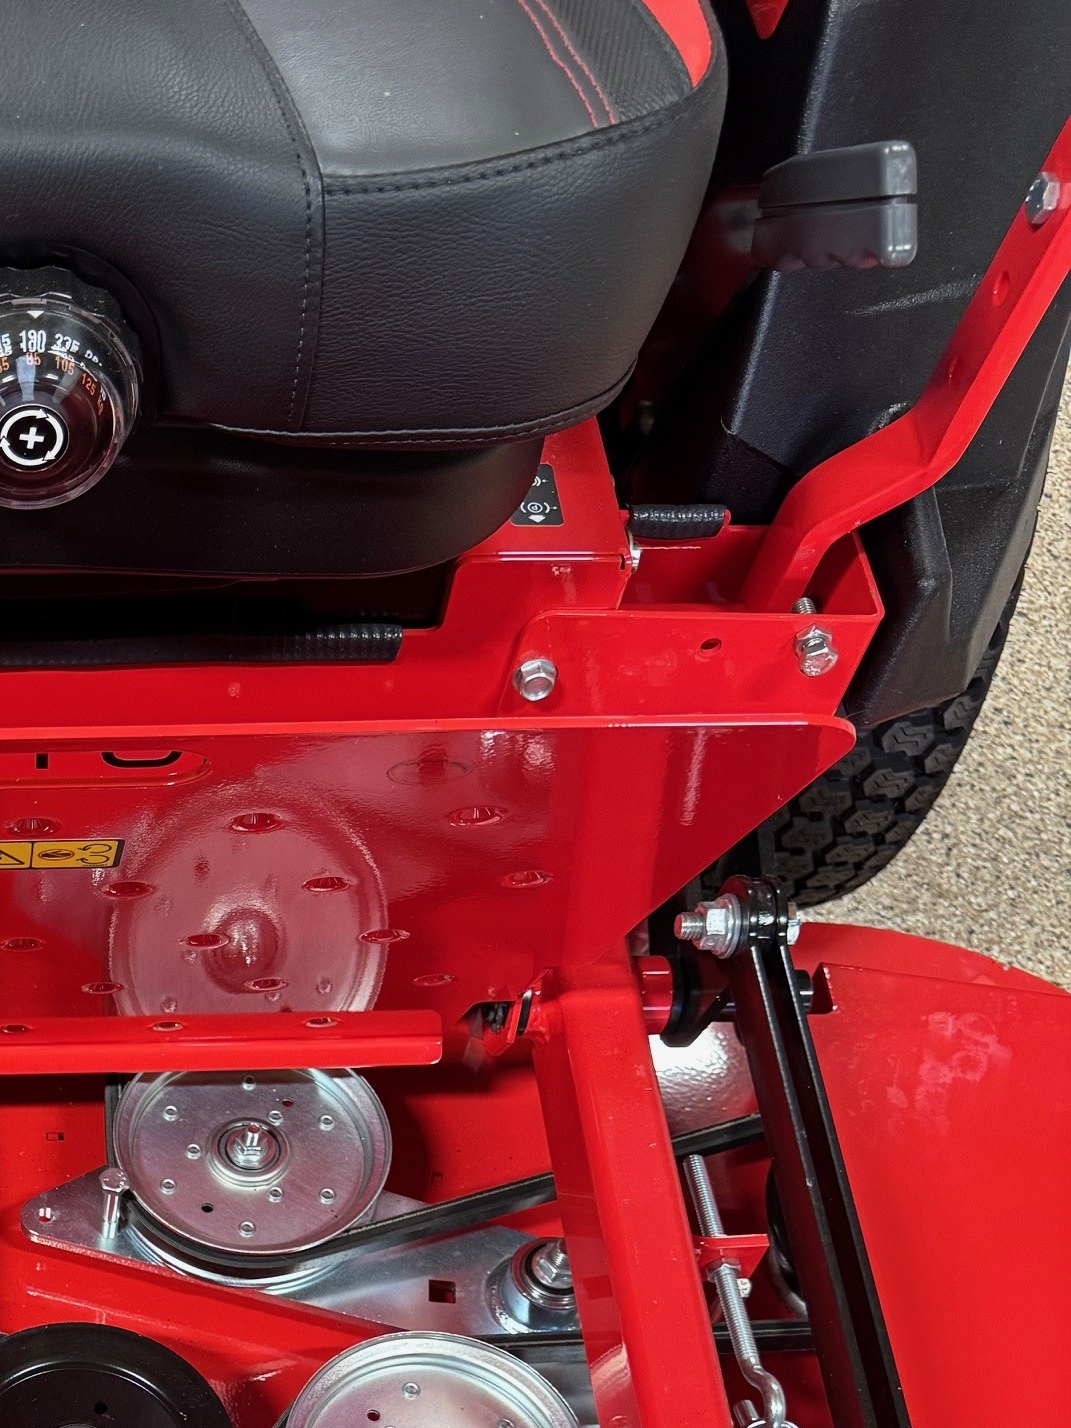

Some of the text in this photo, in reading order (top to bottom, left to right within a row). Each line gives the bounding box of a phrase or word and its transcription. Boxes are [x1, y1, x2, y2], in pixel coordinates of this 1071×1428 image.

[26, 352, 41, 366] 85
[54, 356, 75, 376] 105
[81, 373, 96, 396] 125
